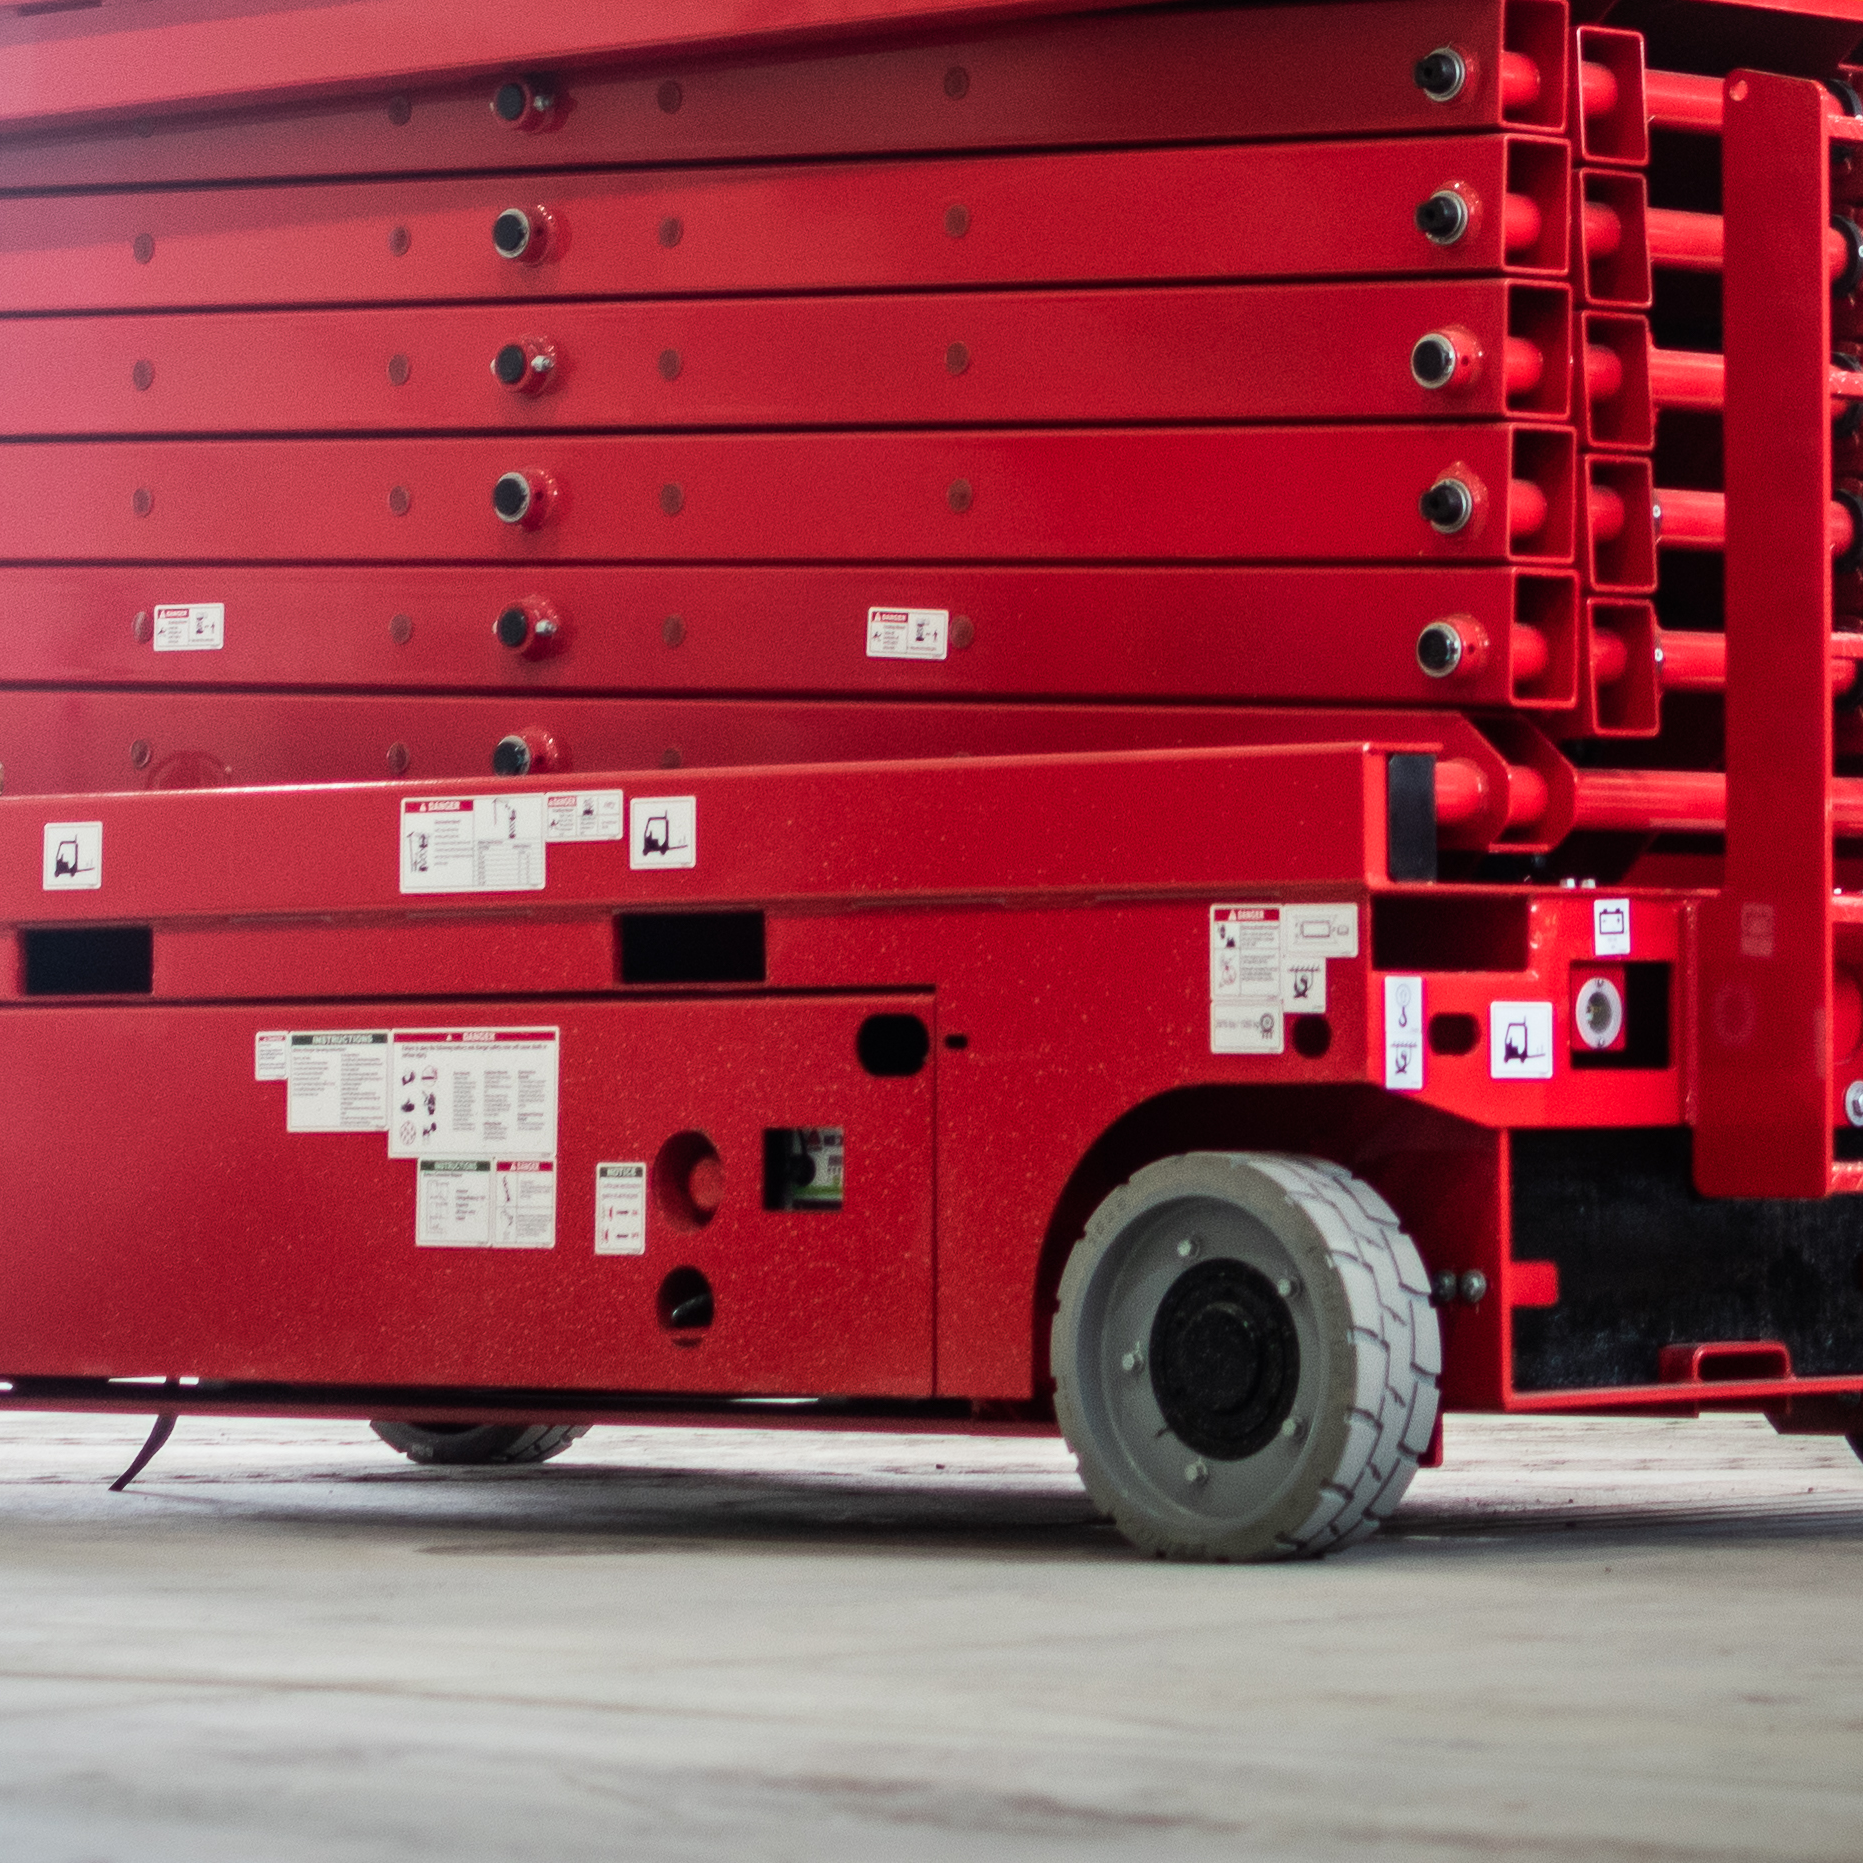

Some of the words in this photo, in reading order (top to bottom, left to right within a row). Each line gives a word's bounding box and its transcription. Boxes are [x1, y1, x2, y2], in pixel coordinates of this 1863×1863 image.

[428, 801, 461, 811] DANGER
[1237, 910, 1265, 920] DANGER
[312, 1035, 373, 1046] INSTRUCTIONS
[462, 1031, 496, 1042] DANGER
